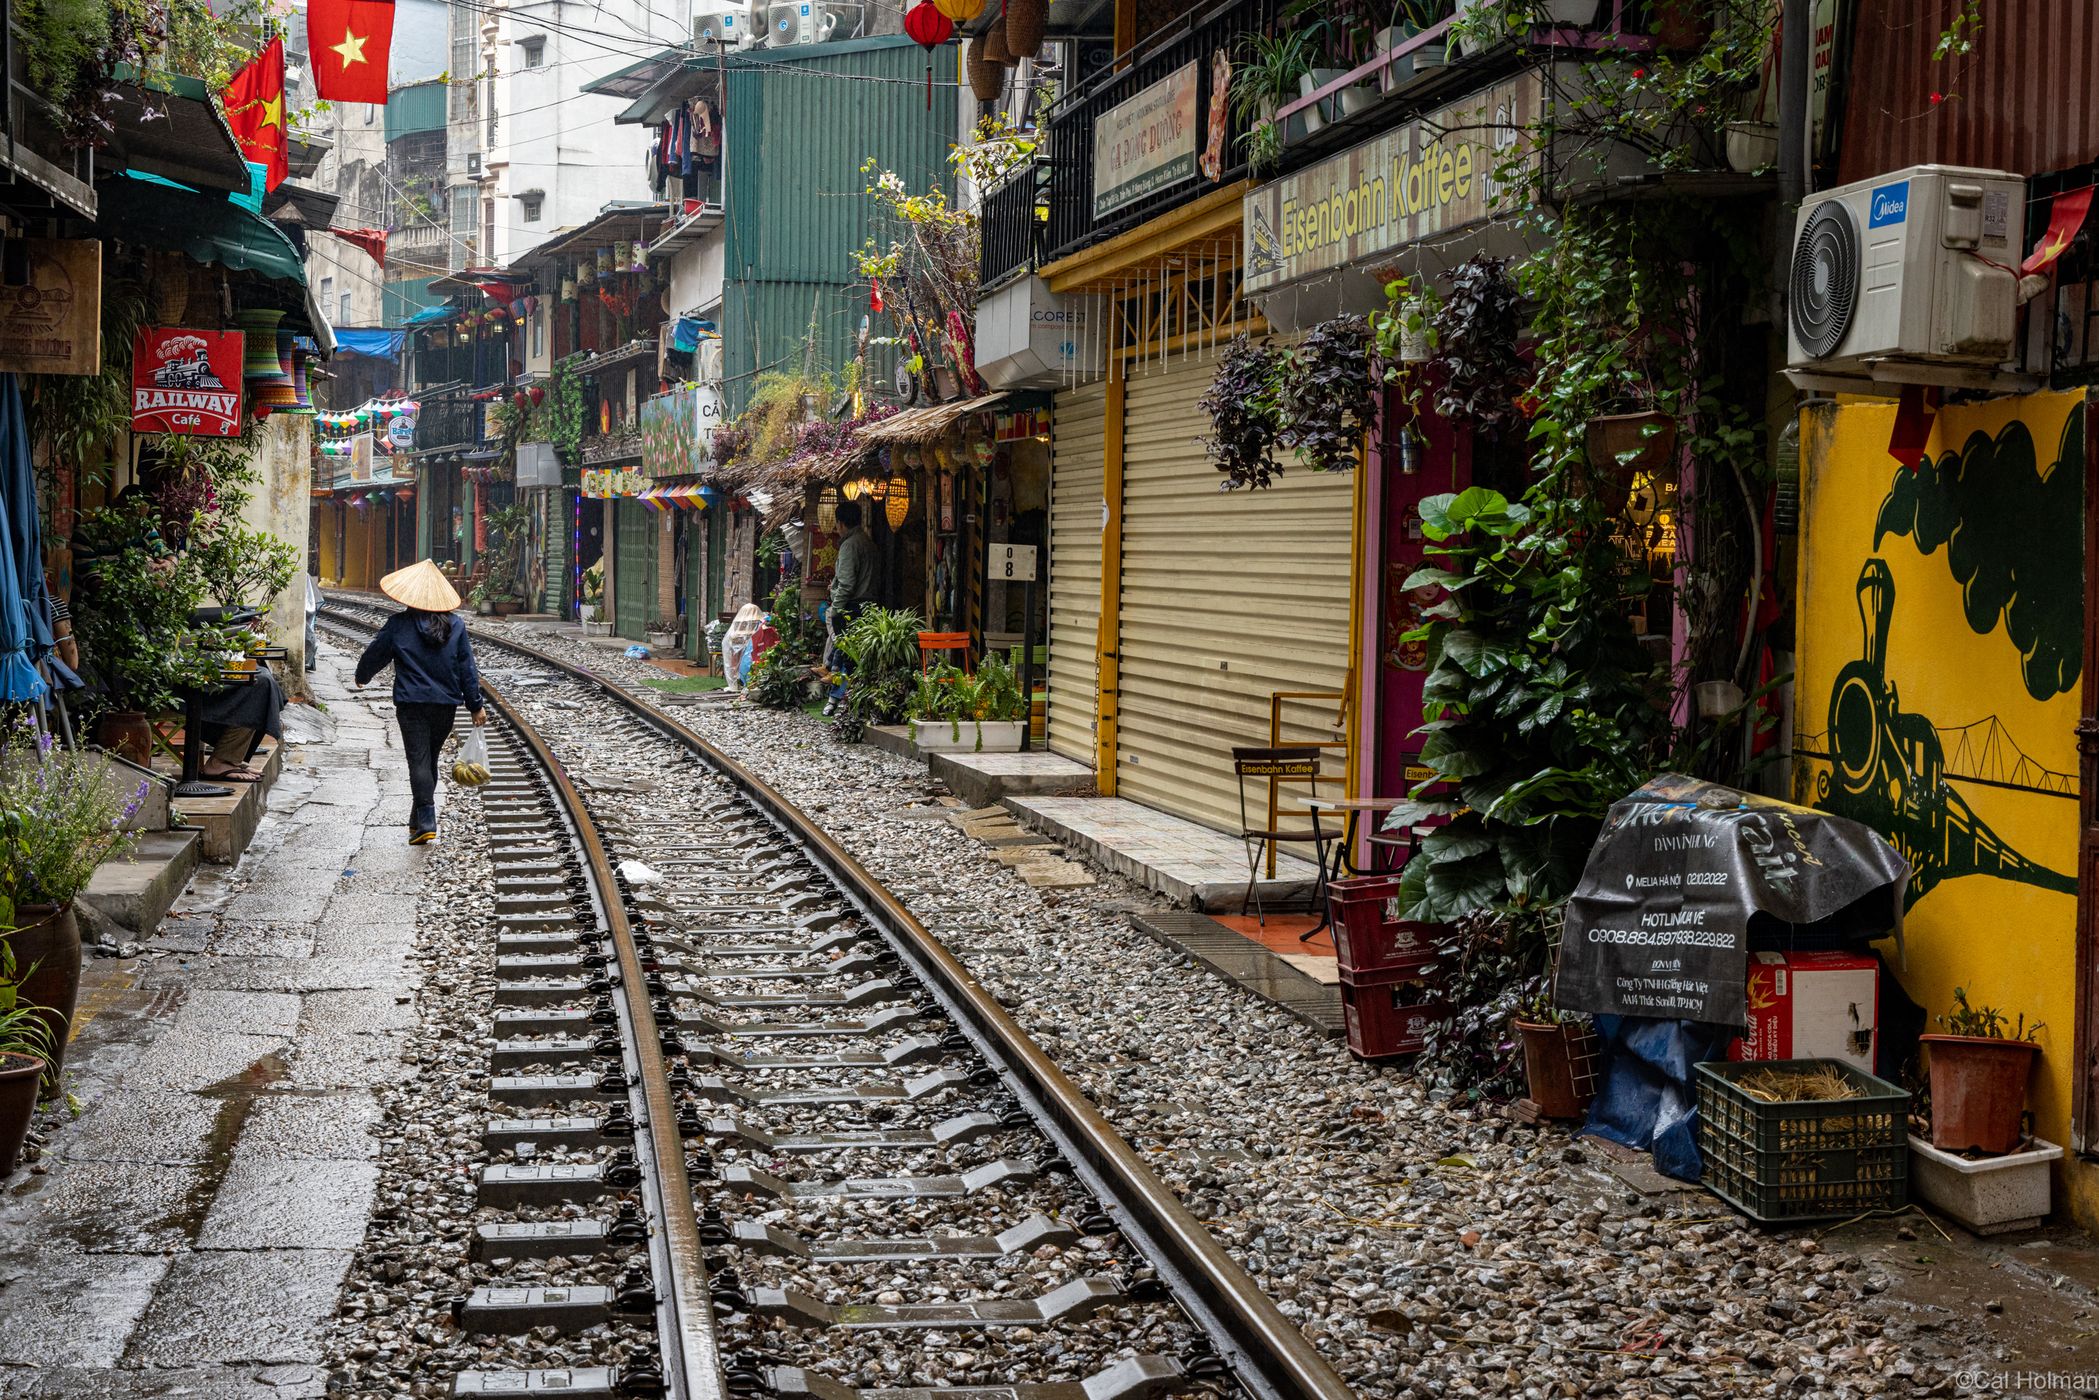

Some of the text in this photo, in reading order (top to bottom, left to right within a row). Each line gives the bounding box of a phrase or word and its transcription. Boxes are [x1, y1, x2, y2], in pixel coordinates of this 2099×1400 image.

[1282, 142, 1473, 260] Eisenbahn Kaffee
[1873, 194, 1904, 220] Midea
[135, 390, 237, 416] RAILWAY
[172, 413, 201, 425] Café
[1241, 764, 1313, 774] Eisenbahn Kaffee
[1636, 877, 1658, 887] MELIA
[1659, 875, 1668, 886] HÀ
[1634, 978, 1642, 991] Ty
